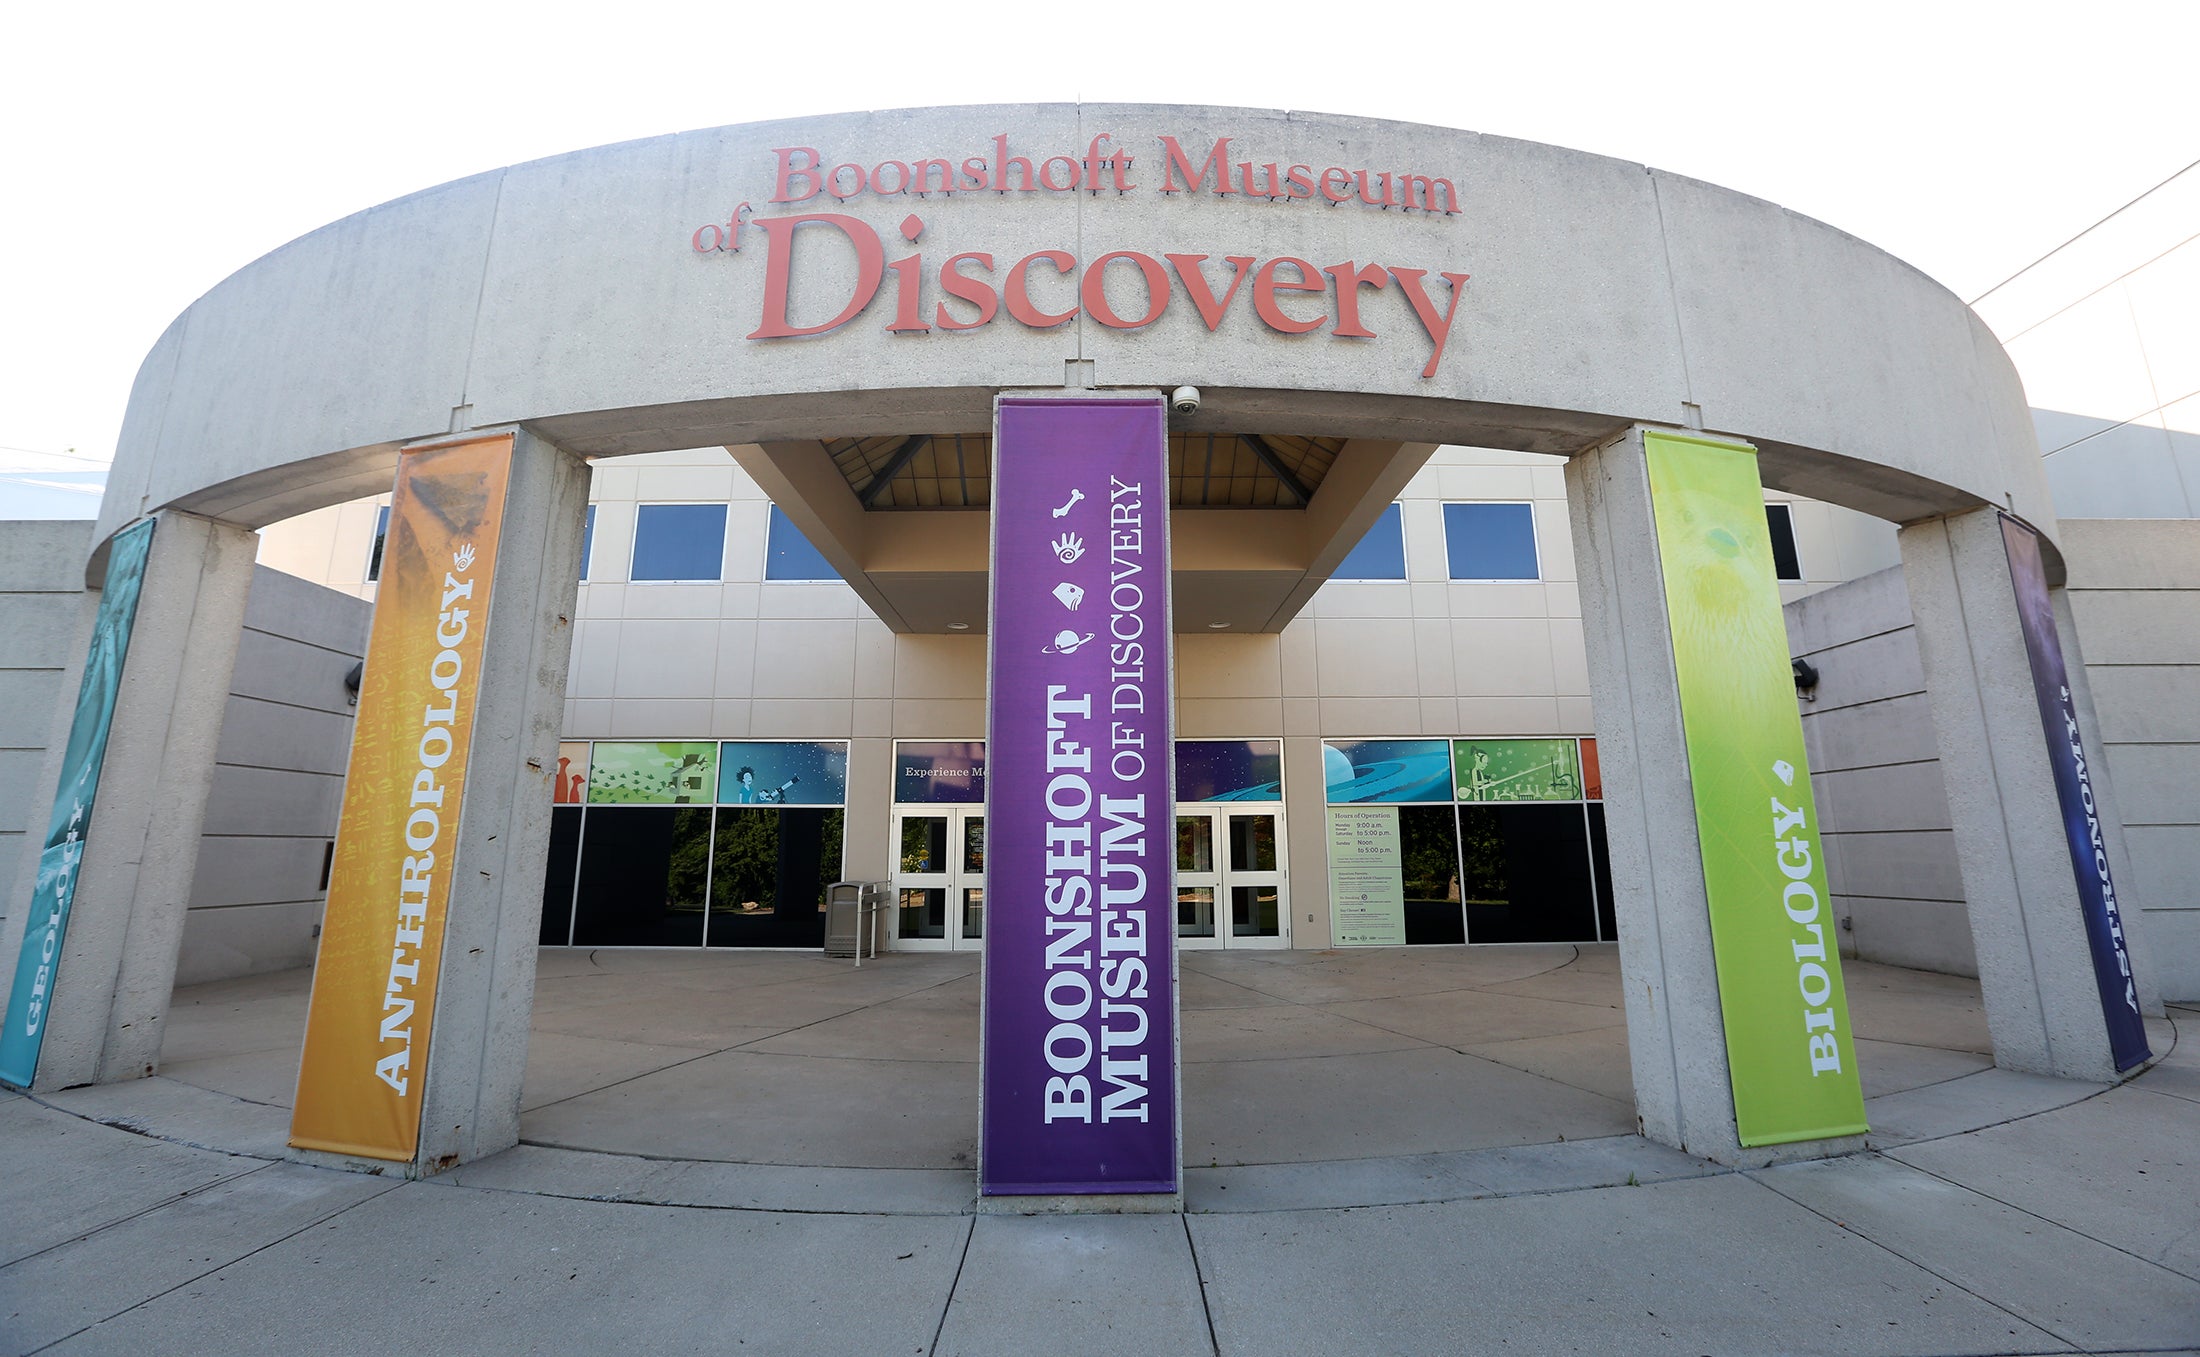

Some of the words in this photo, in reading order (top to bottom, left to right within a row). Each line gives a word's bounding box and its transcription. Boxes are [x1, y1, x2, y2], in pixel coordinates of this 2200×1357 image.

[692, 202, 754, 254] of
[747, 213, 1470, 378] Discovery
[767, 133, 1137, 204] Boonshoft
[1156, 135, 1463, 215] Museum
[1110, 474, 1144, 714] DISCOVERY
[375, 571, 475, 1097] ANTHROPOLOGY
[905, 766, 969, 778] Experience
[971, 767, 985, 777] M
[1111, 721, 1145, 781] OF
[2063, 708, 2139, 1015] ASTRONOMY
[26, 797, 84, 1037] GEOLOGY
[1044, 684, 1092, 1124] BOONSHOFT
[1100, 793, 1149, 1124] MUSEUM
[1770, 796, 1842, 1077] BIOLOGY
